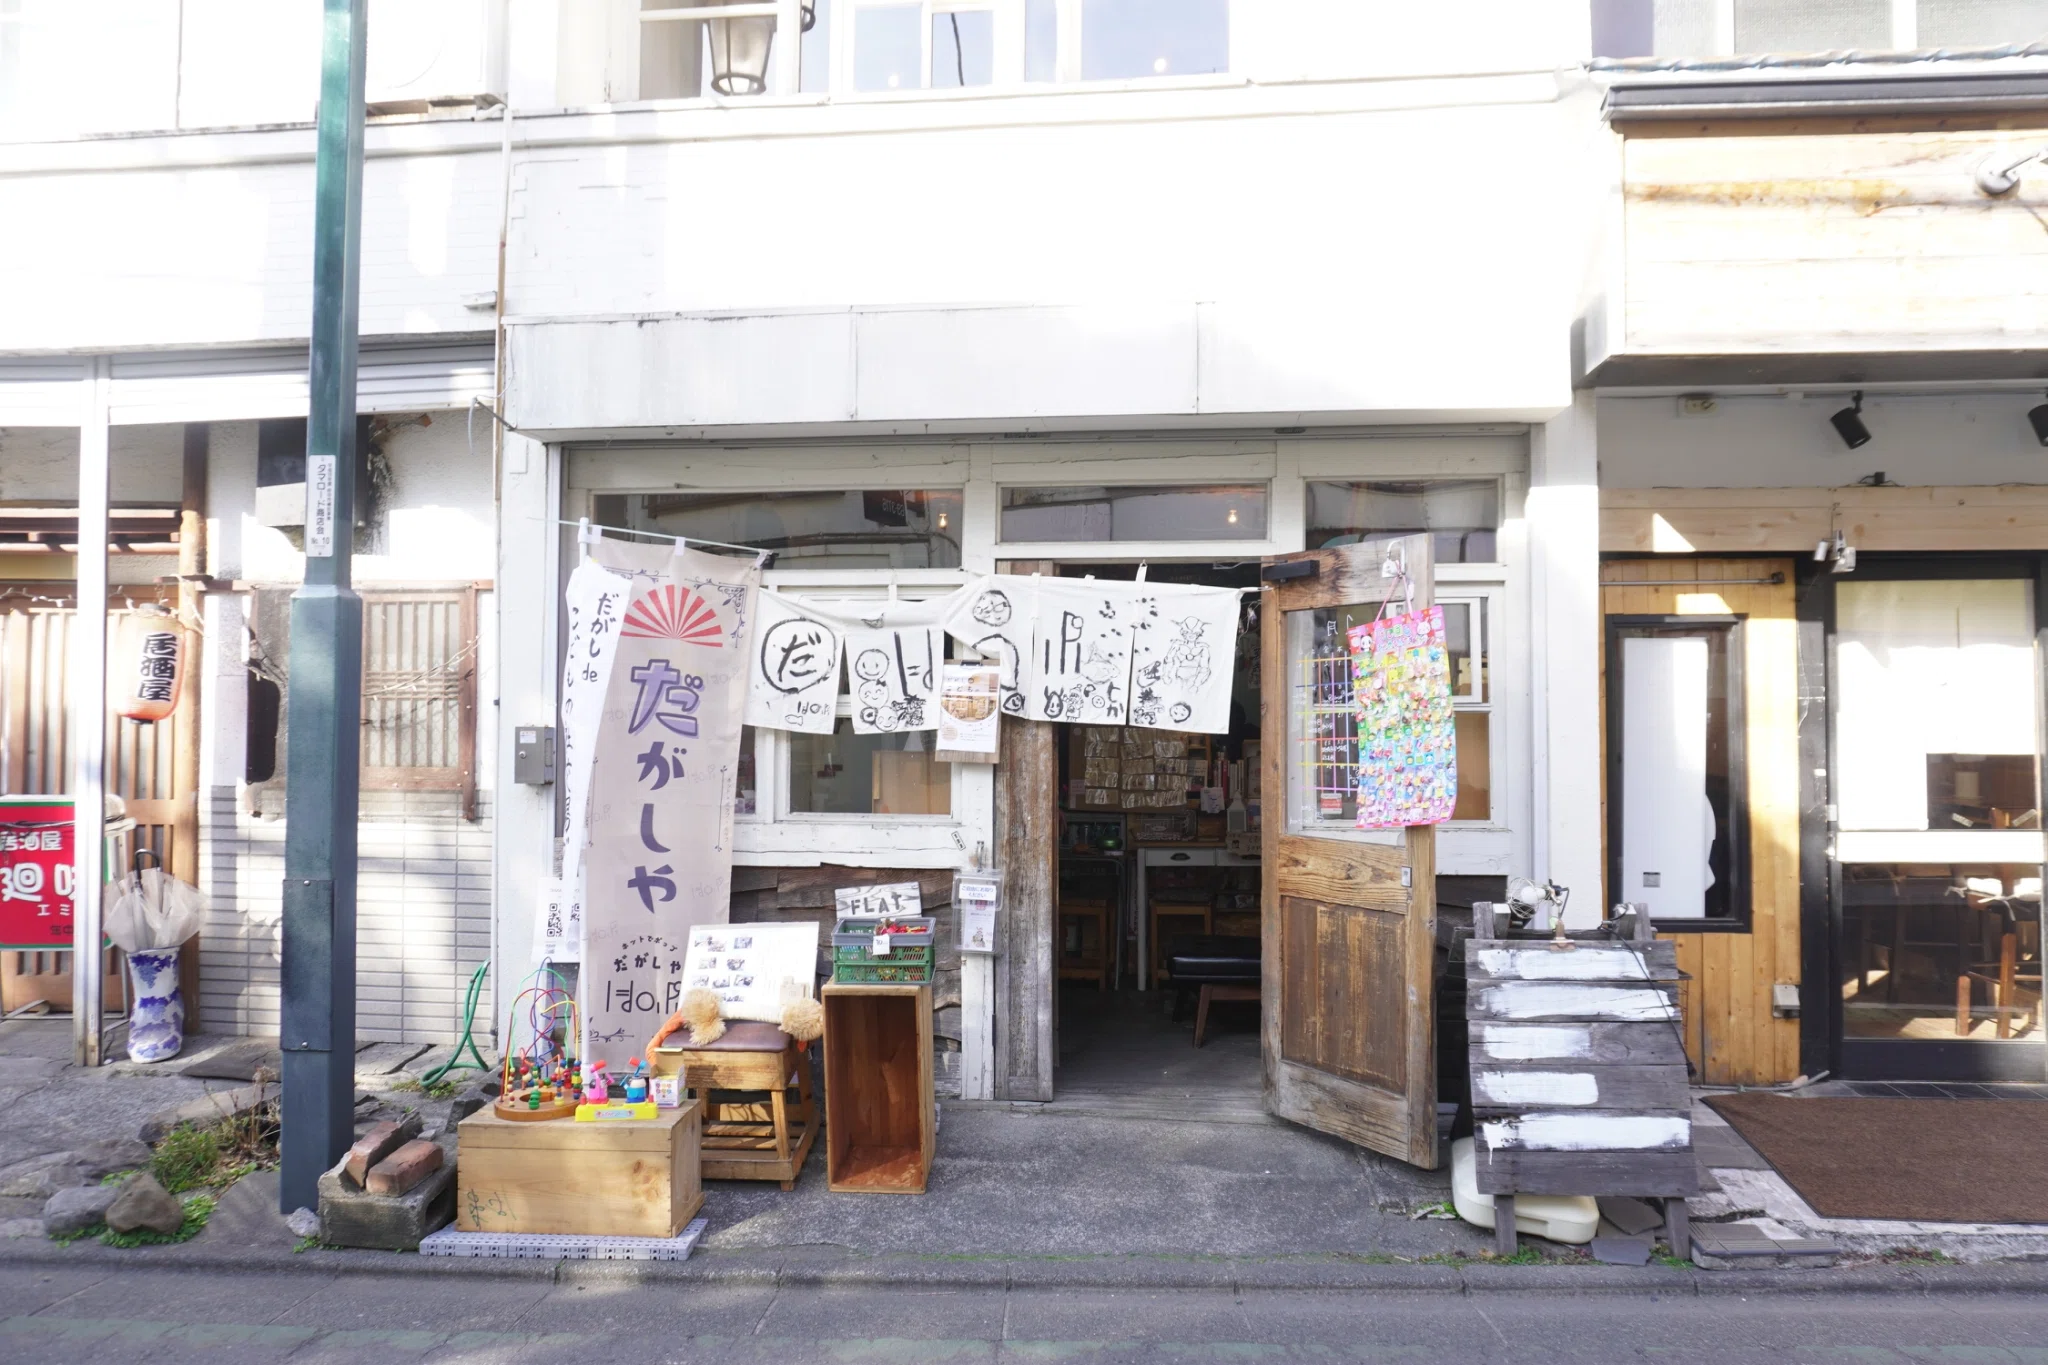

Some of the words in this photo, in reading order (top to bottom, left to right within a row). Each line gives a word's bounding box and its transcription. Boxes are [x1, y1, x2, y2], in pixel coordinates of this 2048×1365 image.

[139, 633, 177, 701] 居酒屋
[627, 658, 705, 914] だがしや
[851, 892, 903, 916] FLAT
[613, 952, 682, 974] だがしや
